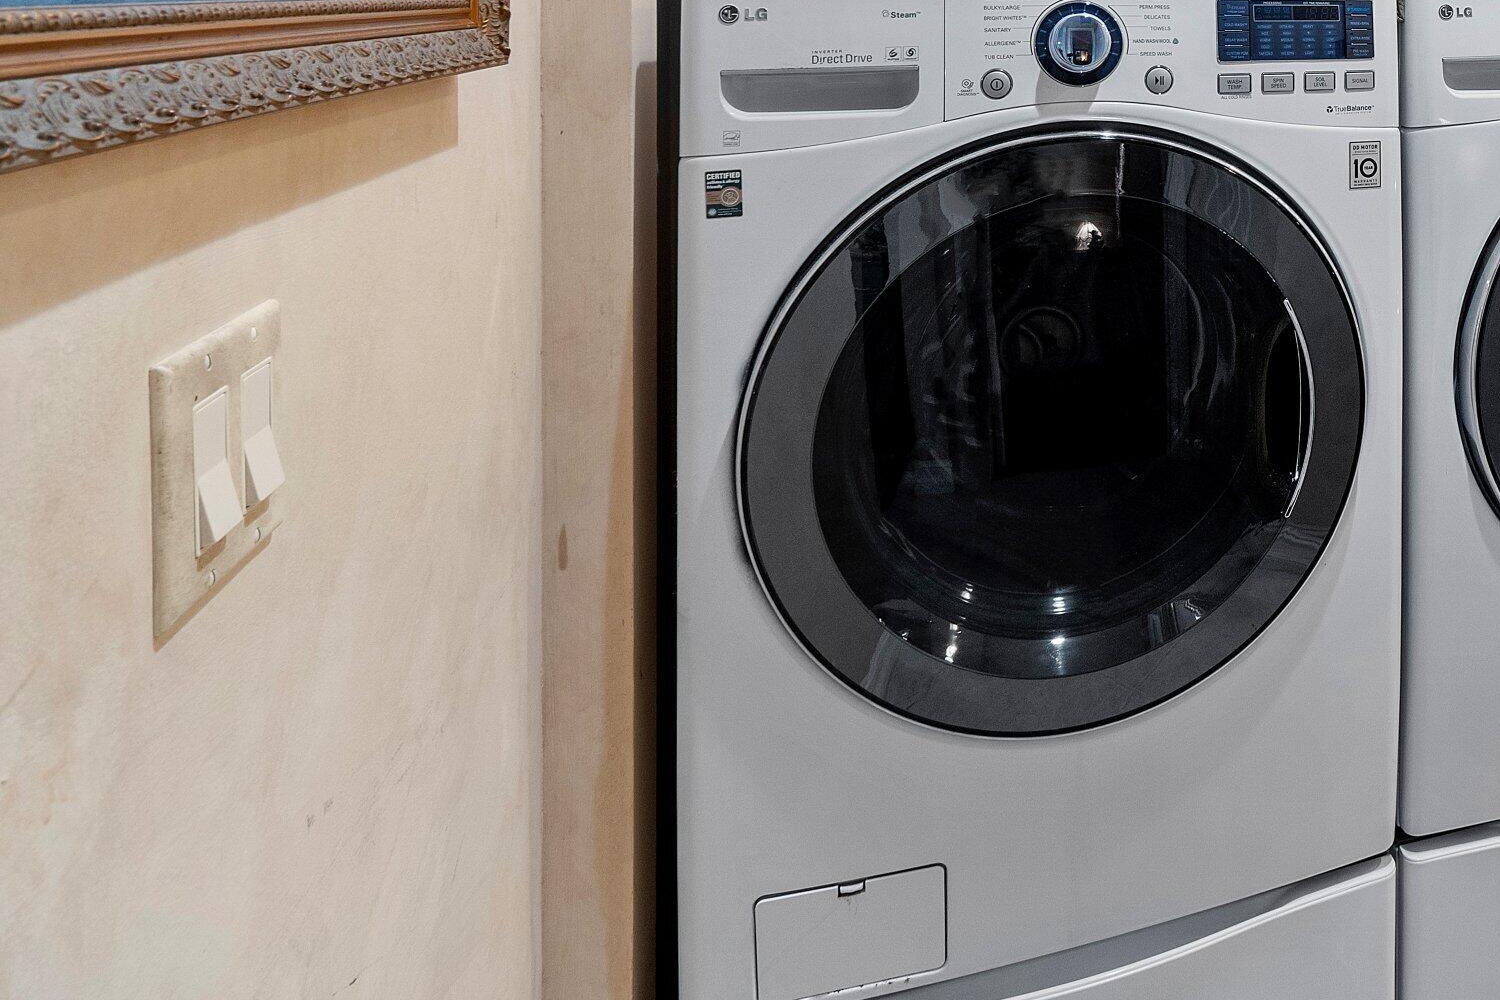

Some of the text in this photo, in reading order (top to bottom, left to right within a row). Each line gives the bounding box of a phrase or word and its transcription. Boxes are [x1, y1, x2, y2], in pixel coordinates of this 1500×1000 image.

[812, 54, 873, 65] Direct Drive
[1353, 157, 1378, 179] 10
[706, 171, 741, 181] CERTIFIED
